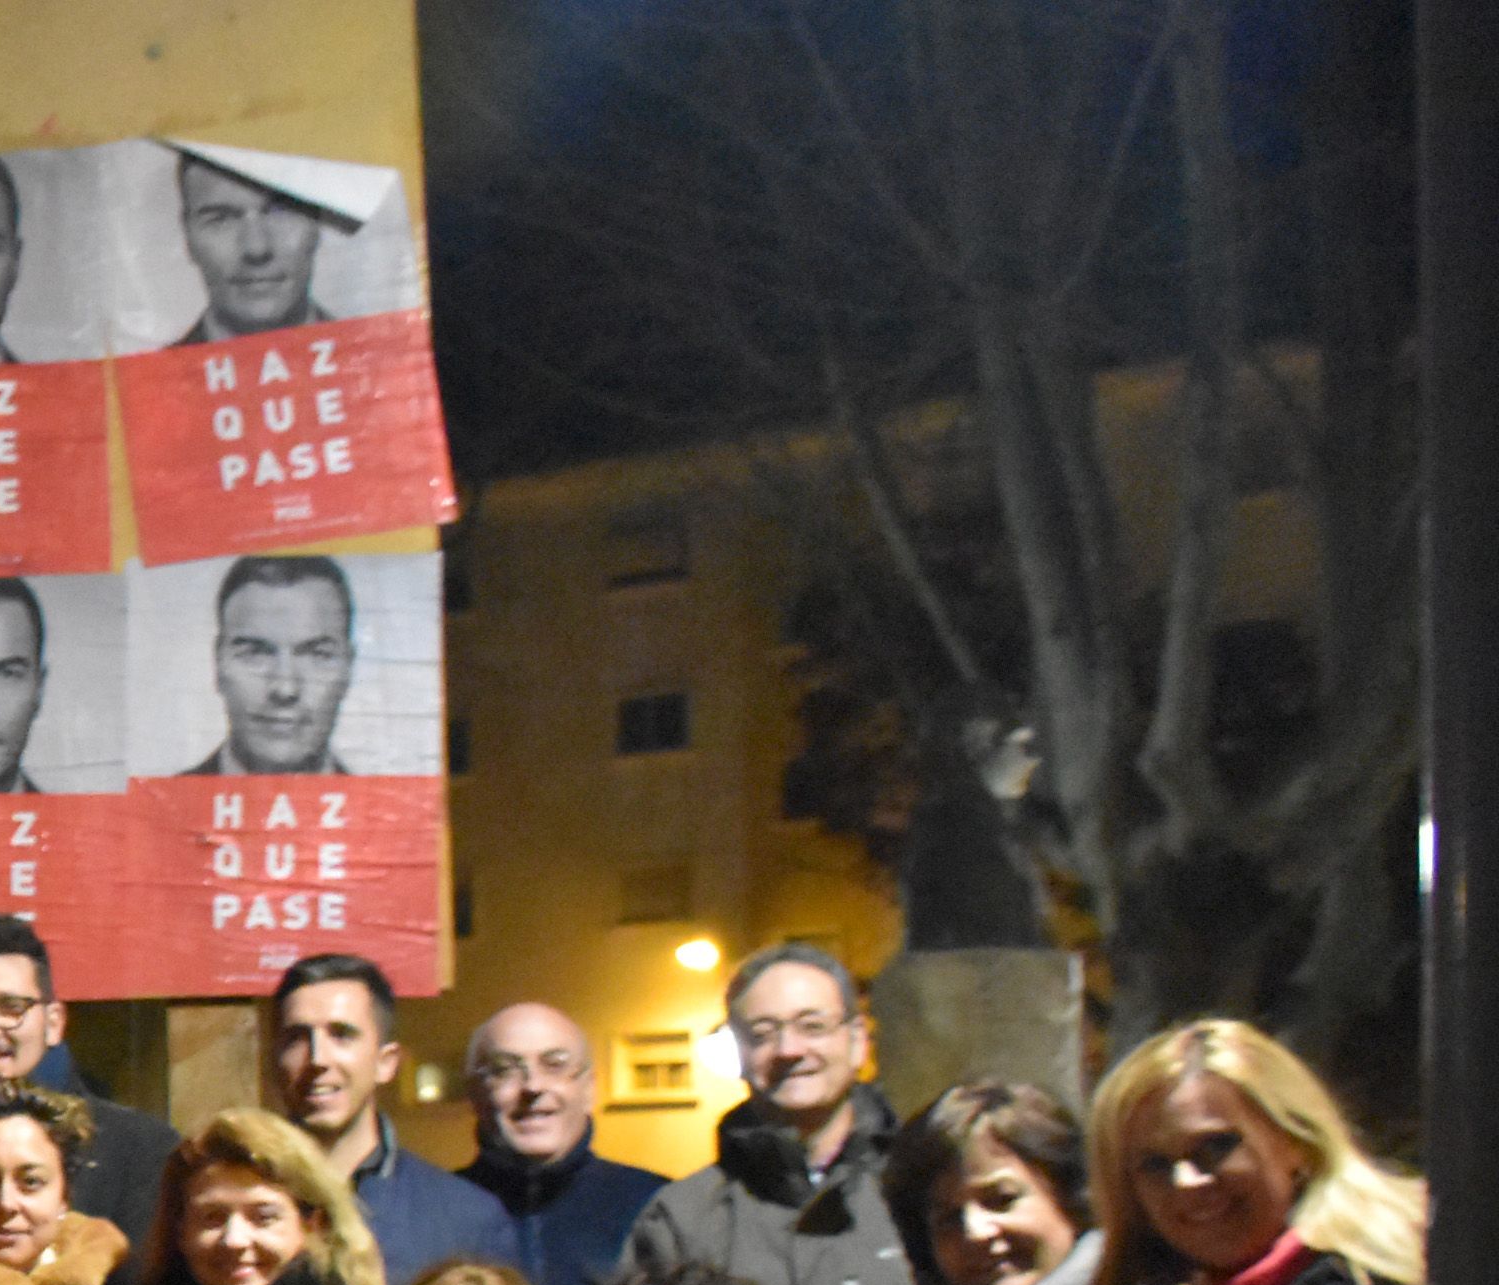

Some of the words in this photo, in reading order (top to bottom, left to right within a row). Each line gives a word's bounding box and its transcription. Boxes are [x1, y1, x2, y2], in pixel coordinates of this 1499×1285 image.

[204, 339, 338, 393] HAZ
[213, 389, 345, 441] QUE
[220, 438, 353, 490] PASE
[212, 793, 347, 829] HAZ
[212, 842, 347, 880] QUE
[212, 894, 347, 930] PASE
